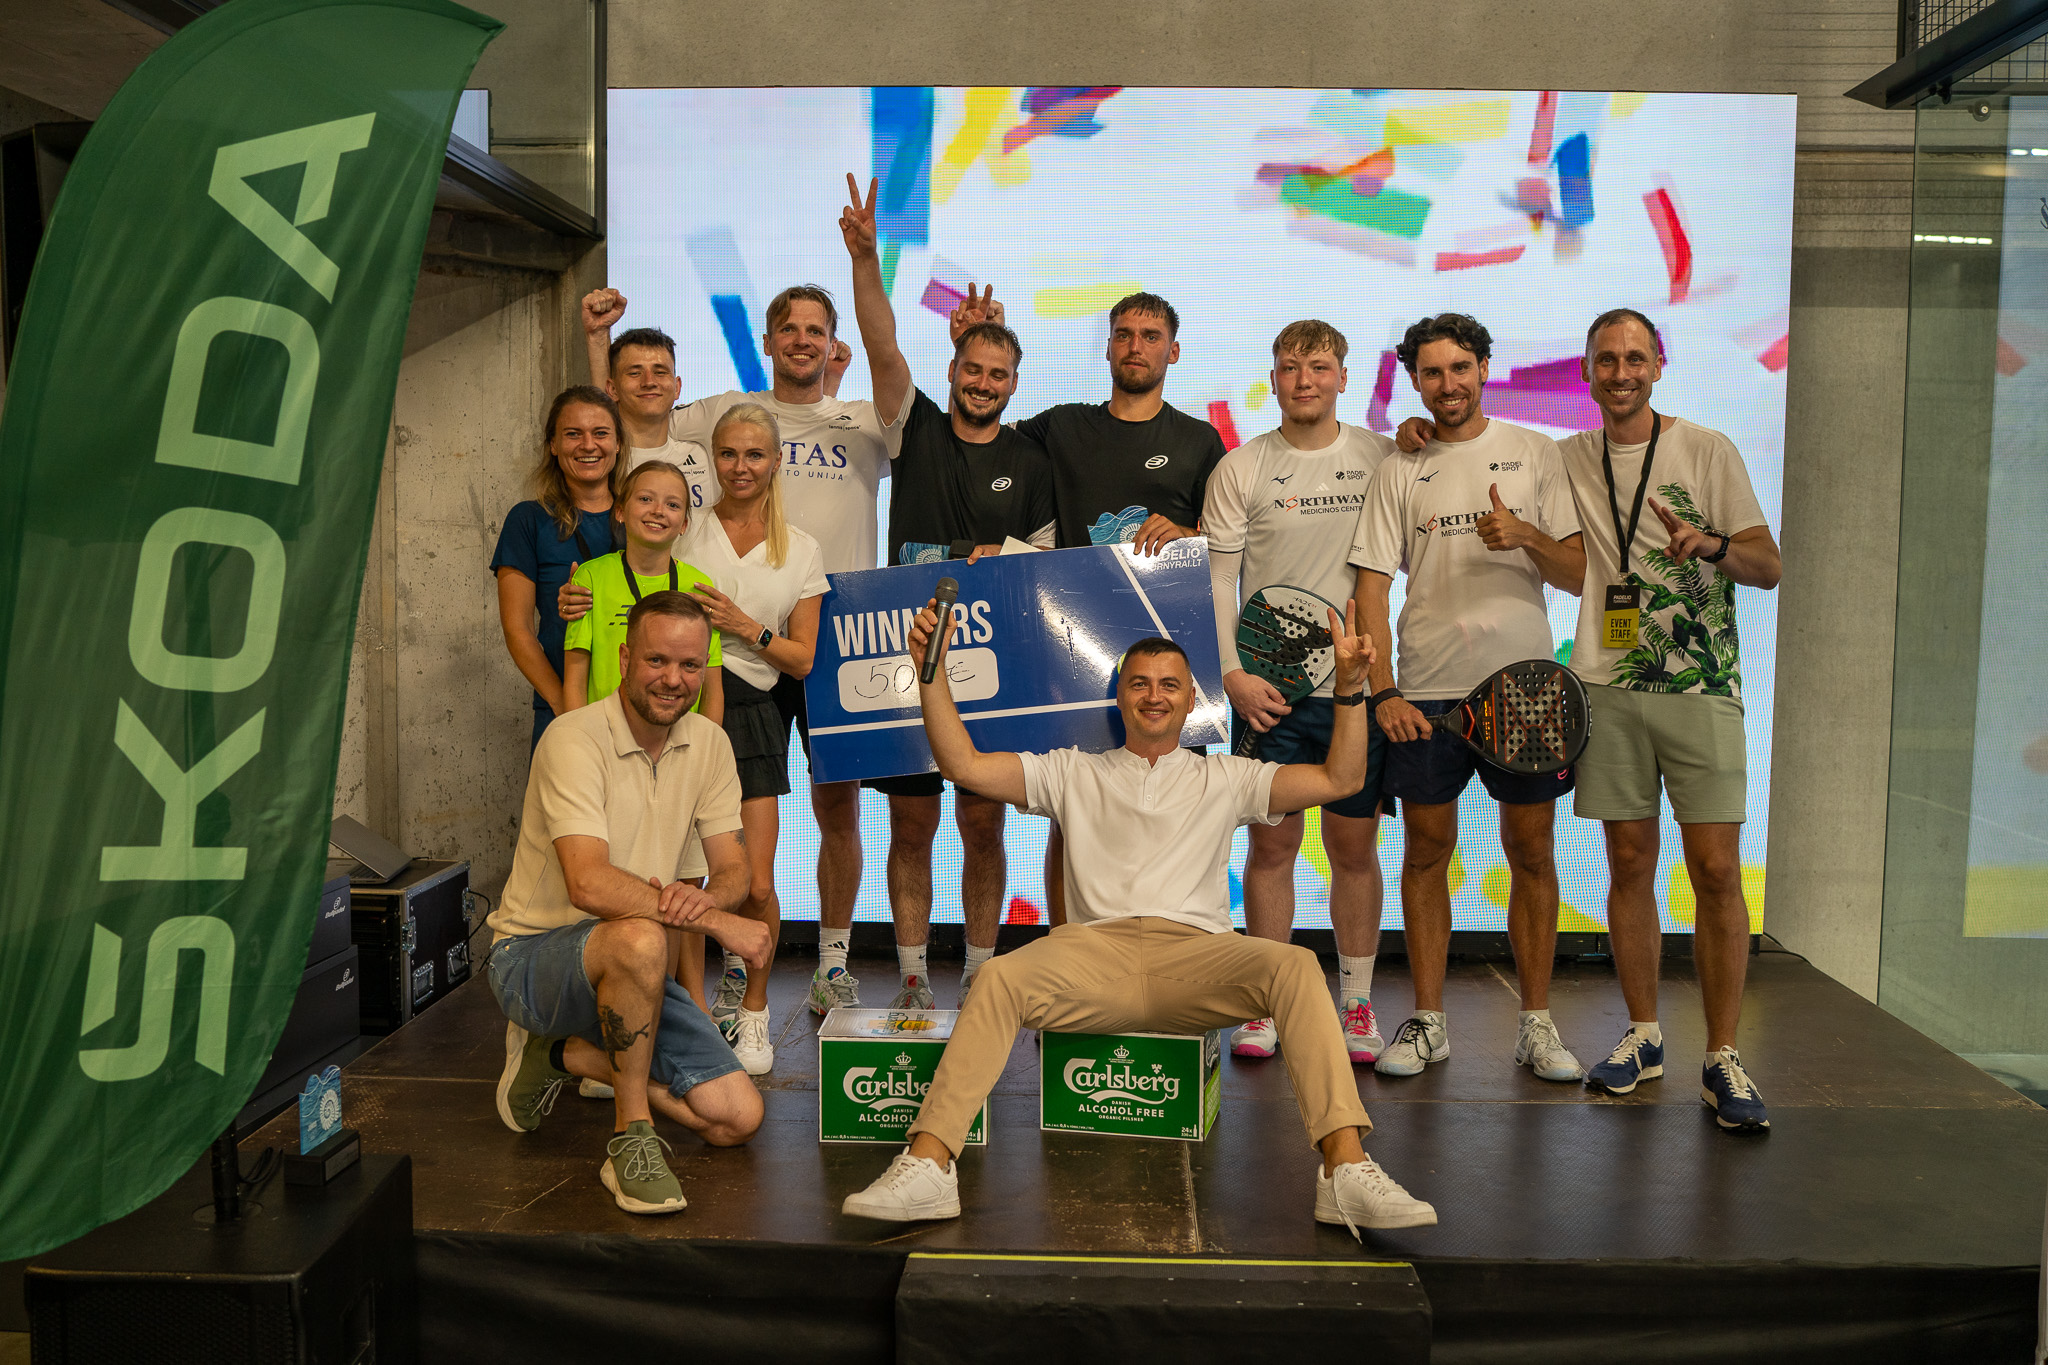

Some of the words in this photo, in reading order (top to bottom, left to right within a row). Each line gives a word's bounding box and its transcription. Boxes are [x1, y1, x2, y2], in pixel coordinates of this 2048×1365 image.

[782, 440, 847, 468] TAS
[785, 469, 800, 477] TO
[808, 471, 843, 481] UNIJA
[1300, 505, 1340, 515] MEDICINOS
[1340, 505, 1363, 513] CENTR
[1441, 525, 1479, 538] MEDICINO
[1161, 547, 1201, 561] DELIO
[1151, 558, 1203, 571] URNYRAI.LT
[833, 600, 994, 658] WINNRS
[1610, 618, 1632, 628] EVENT
[1610, 629, 1631, 639] STAFF
[842, 1066, 932, 1104] Carlsbe
[1063, 1057, 1181, 1102] Carlsberg
[1078, 1103, 1133, 1116] ALCOHOL
[1136, 1107, 1165, 1118] FREE
[858, 1113, 915, 1123] ALCOHOL
